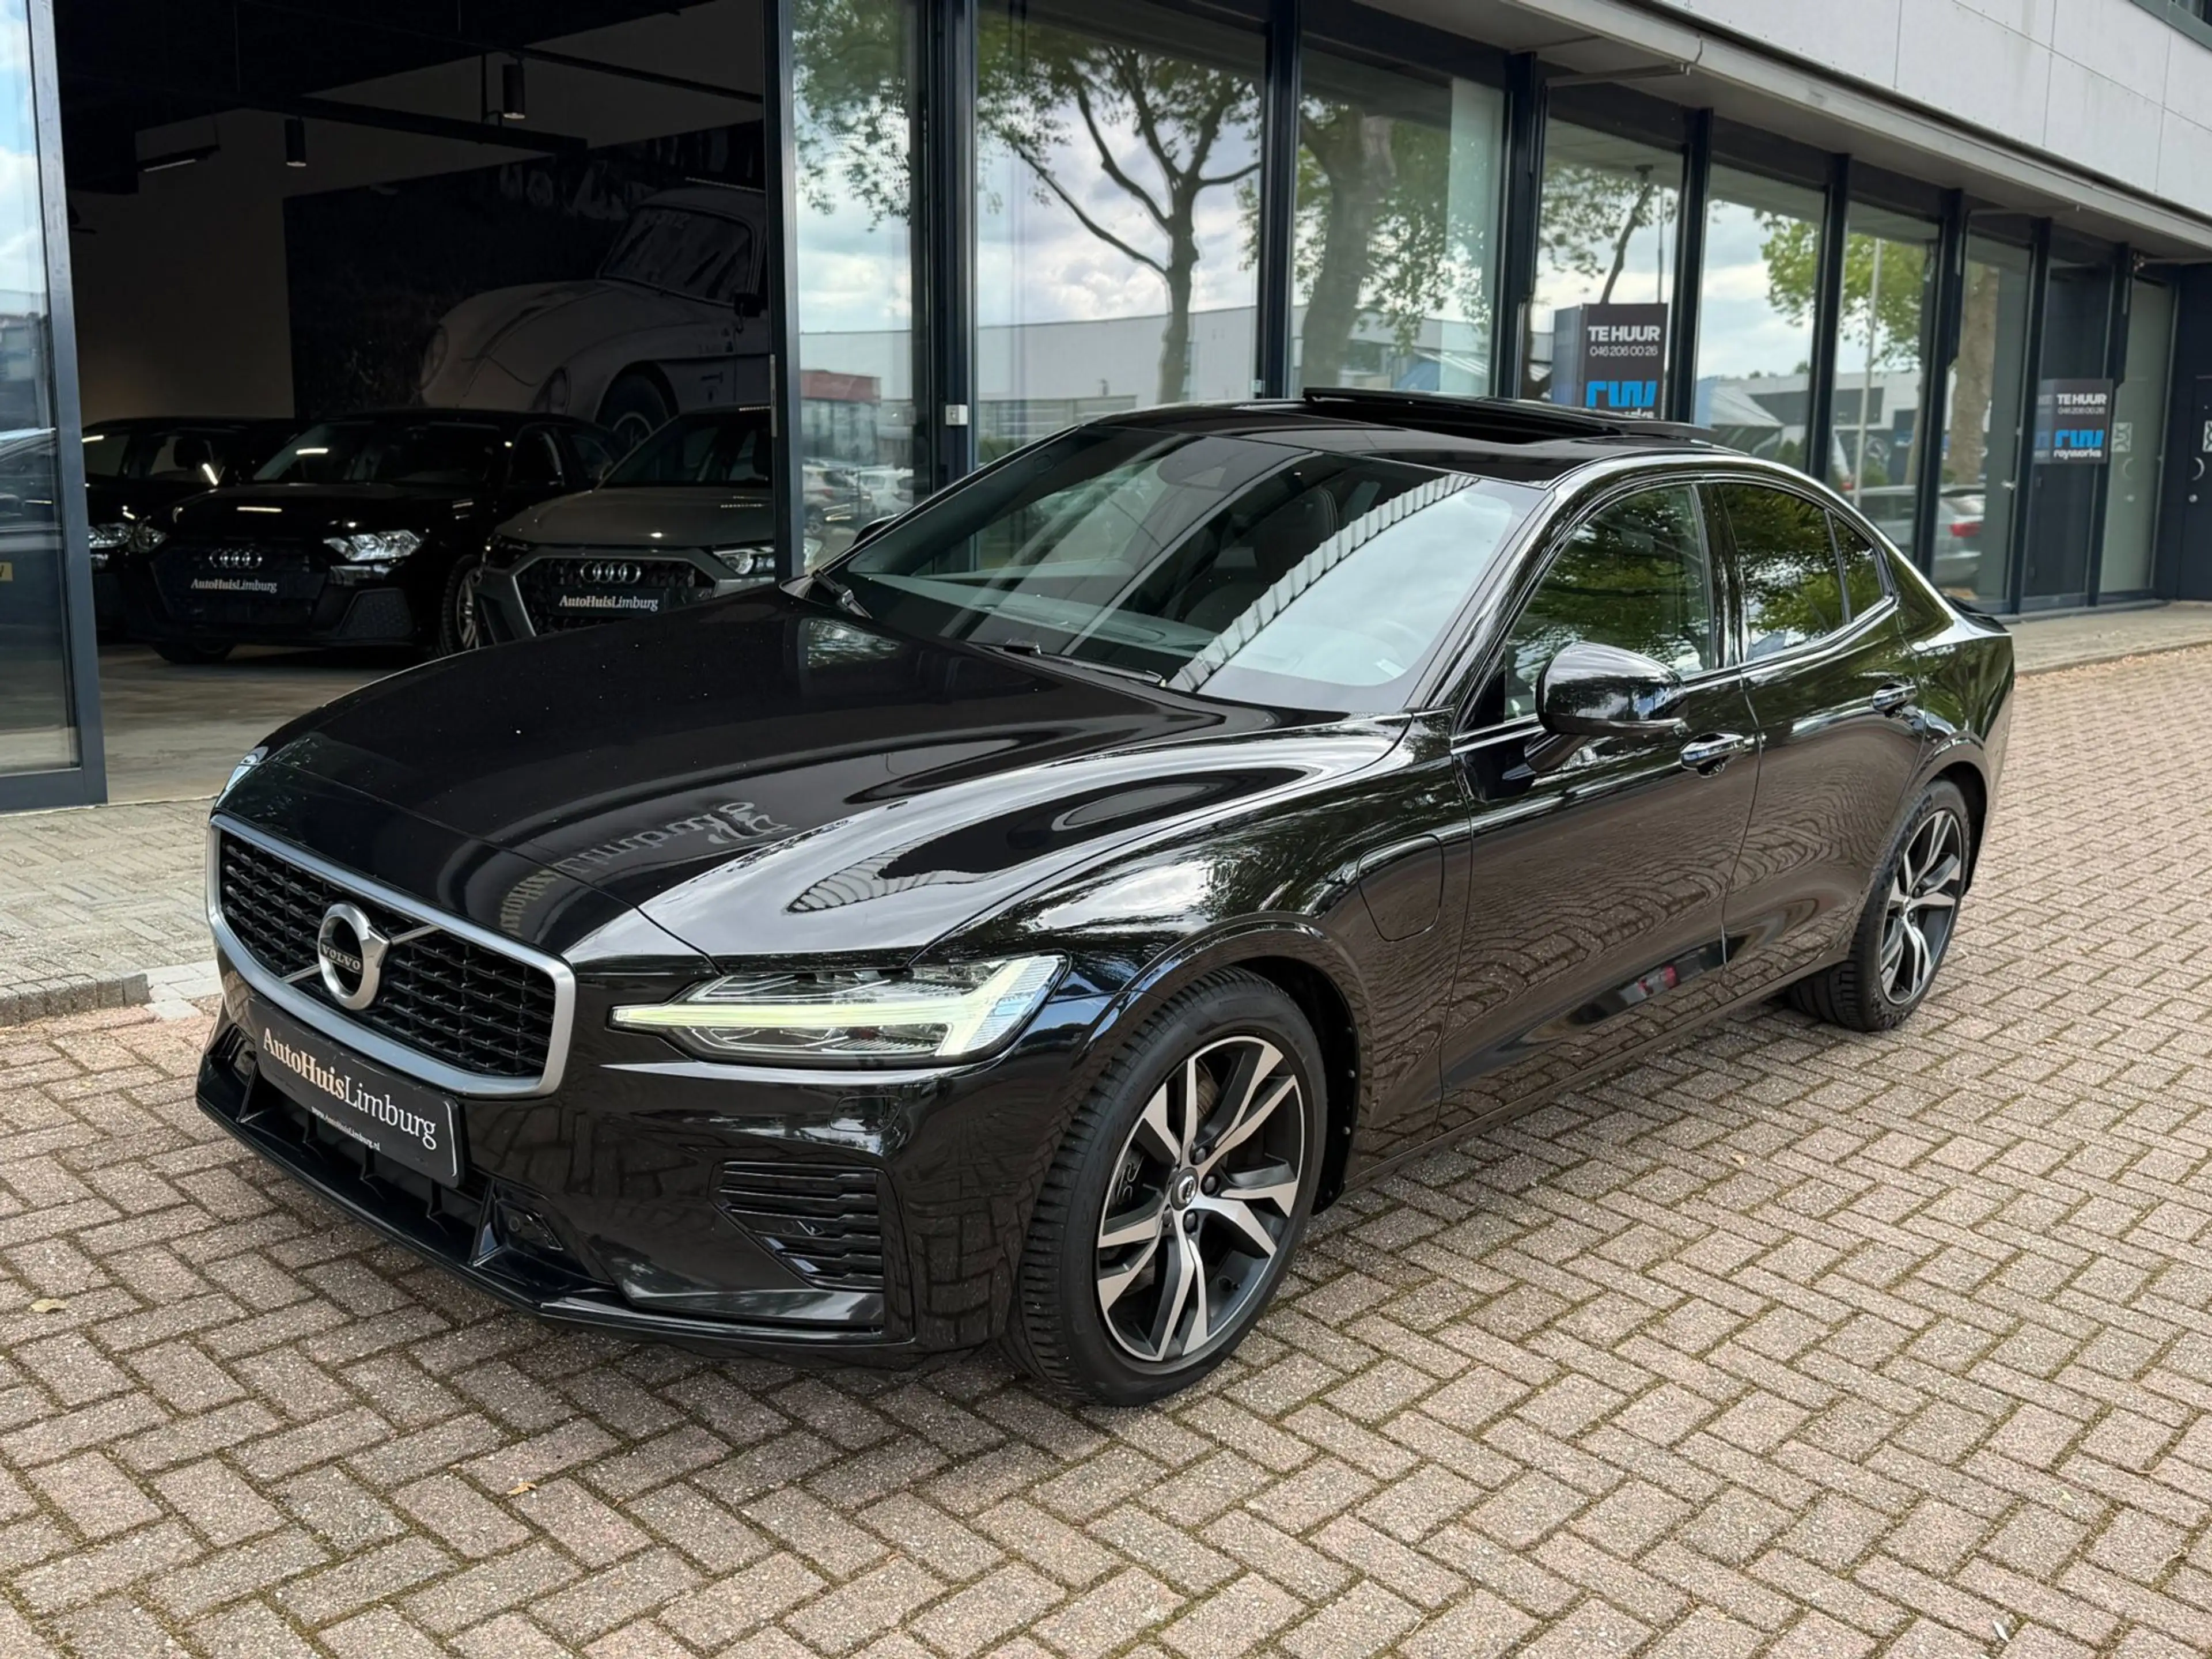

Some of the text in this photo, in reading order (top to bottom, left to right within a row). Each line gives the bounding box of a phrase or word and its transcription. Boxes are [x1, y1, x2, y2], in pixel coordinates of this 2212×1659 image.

[1587, 325, 1661, 342] TE HUUR
[2056, 393, 2071, 405] TE
[2073, 393, 2107, 405] HUUR
[191, 578, 278, 593] AutoHuisLimburg
[559, 594, 659, 612] AutoHuisLimburg
[322, 945, 362, 972] VOLVO
[263, 1027, 437, 1151] AutoHuisLimburg
